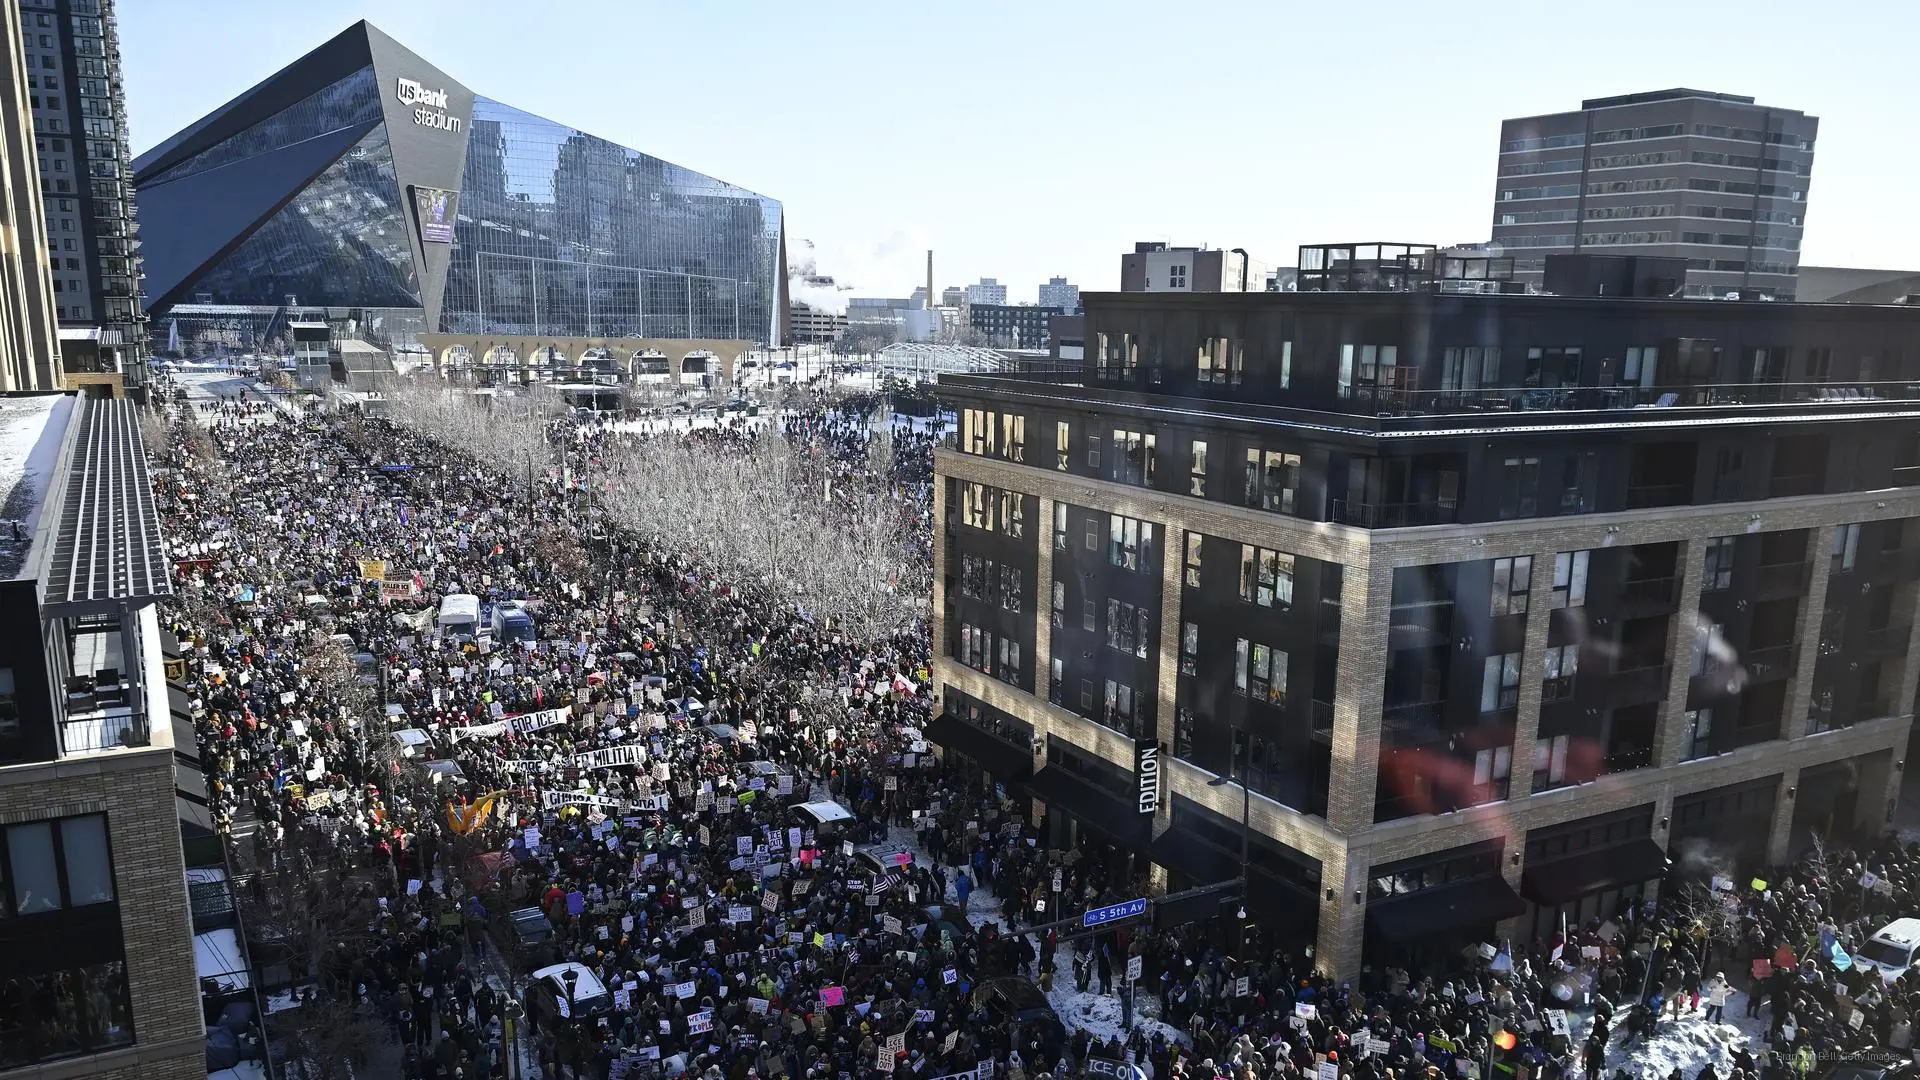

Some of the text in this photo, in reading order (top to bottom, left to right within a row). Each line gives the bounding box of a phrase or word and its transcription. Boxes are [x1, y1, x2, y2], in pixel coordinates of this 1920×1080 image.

[413, 107, 461, 133] stadium
[511, 715, 534, 733] FOR
[536, 710, 559, 727] ICE!
[1139, 747, 1158, 813] EDITION
[323, 818, 339, 826] ICE
[769, 830, 781, 838] ICE
[765, 893, 776, 902] ICE
[1099, 902, 1144, 920] S 5th Av
[691, 912, 704, 920] ICE
[1129, 965, 1141, 973] ONE
[1128, 971, 1141, 979] WAY
[688, 1012, 711, 1023] WE THE
[888, 1038, 902, 1046] ICE
[879, 1052, 892, 1061] ICE
[878, 1060, 893, 1069] OUT!
[1088, 1059, 1114, 1076] ICE
